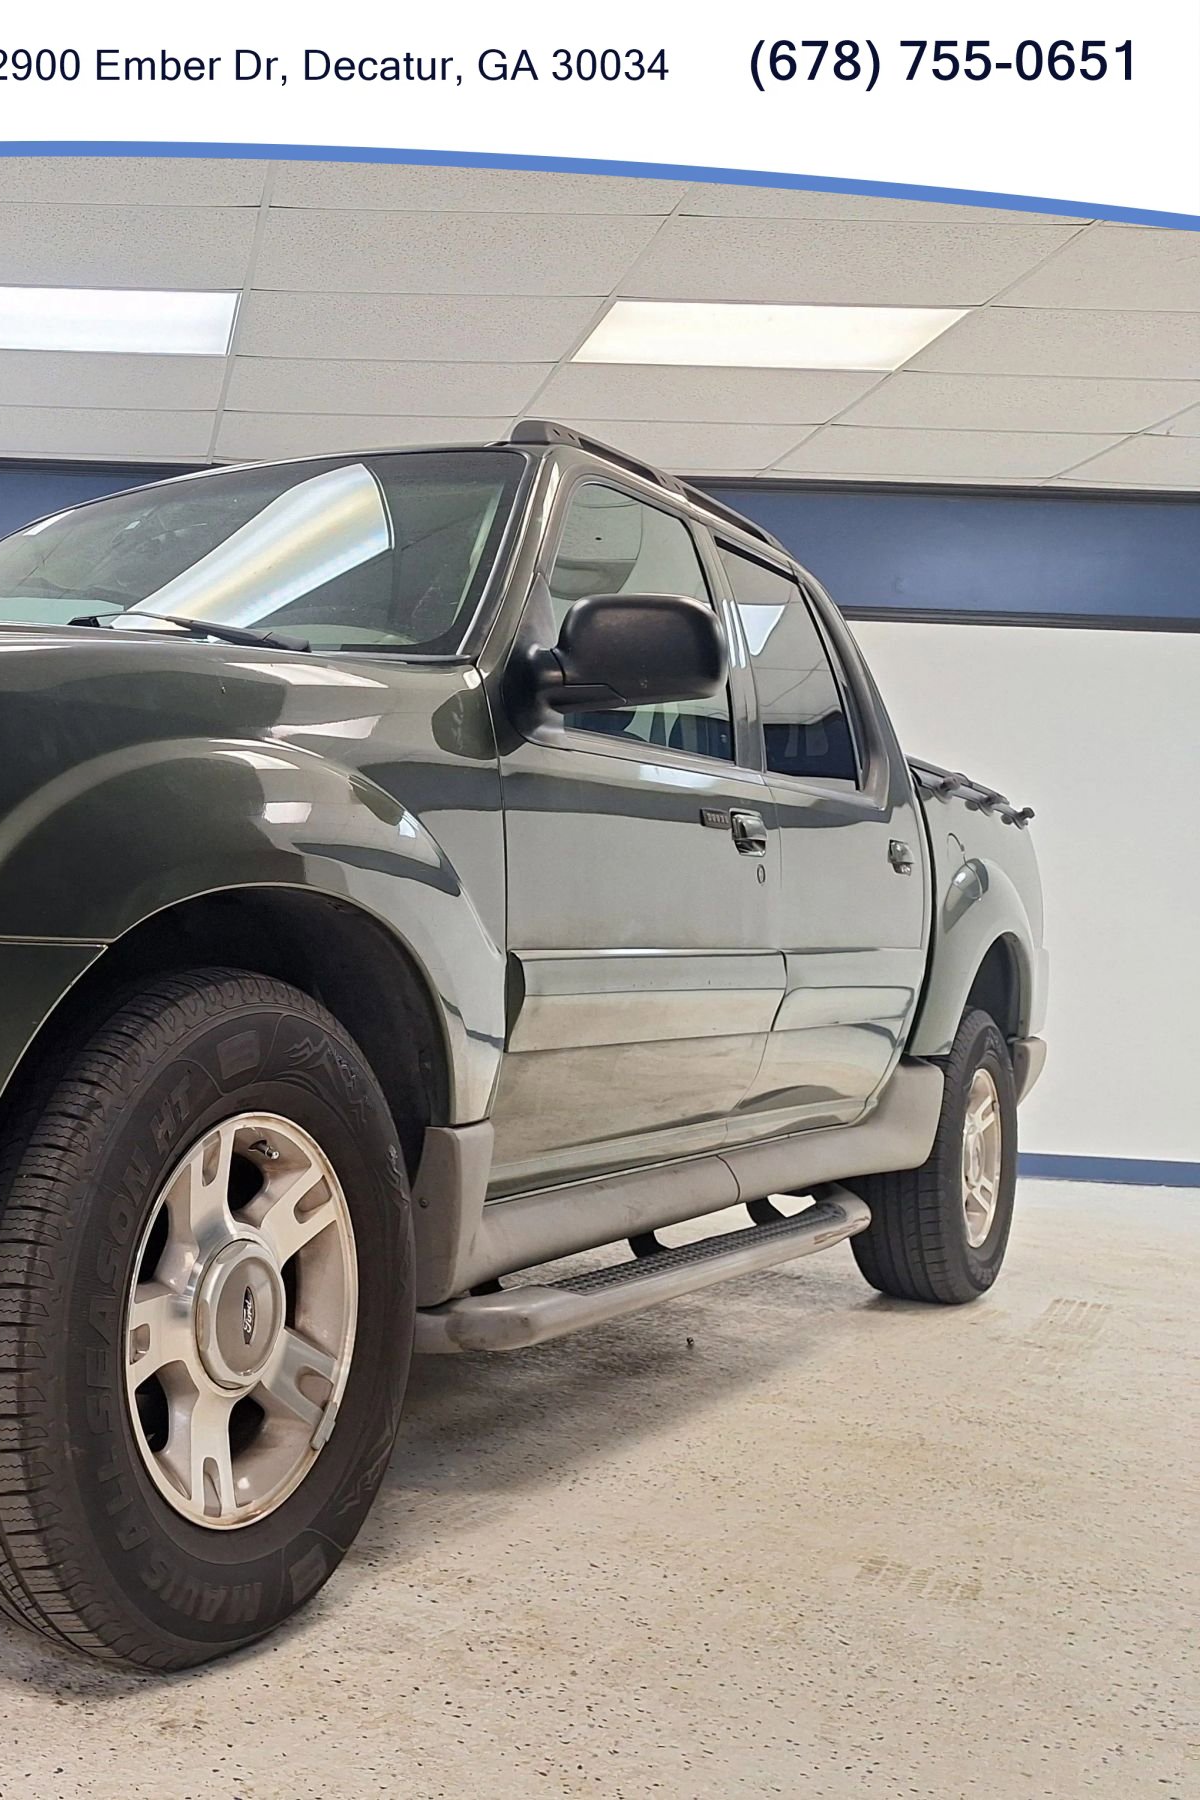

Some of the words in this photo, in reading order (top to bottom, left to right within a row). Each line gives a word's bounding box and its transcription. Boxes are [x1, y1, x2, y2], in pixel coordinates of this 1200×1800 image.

[149, 1071, 192, 1157] HT
[86, 1141, 152, 1435] SEASON
[97, 1444, 151, 1551] ALL
